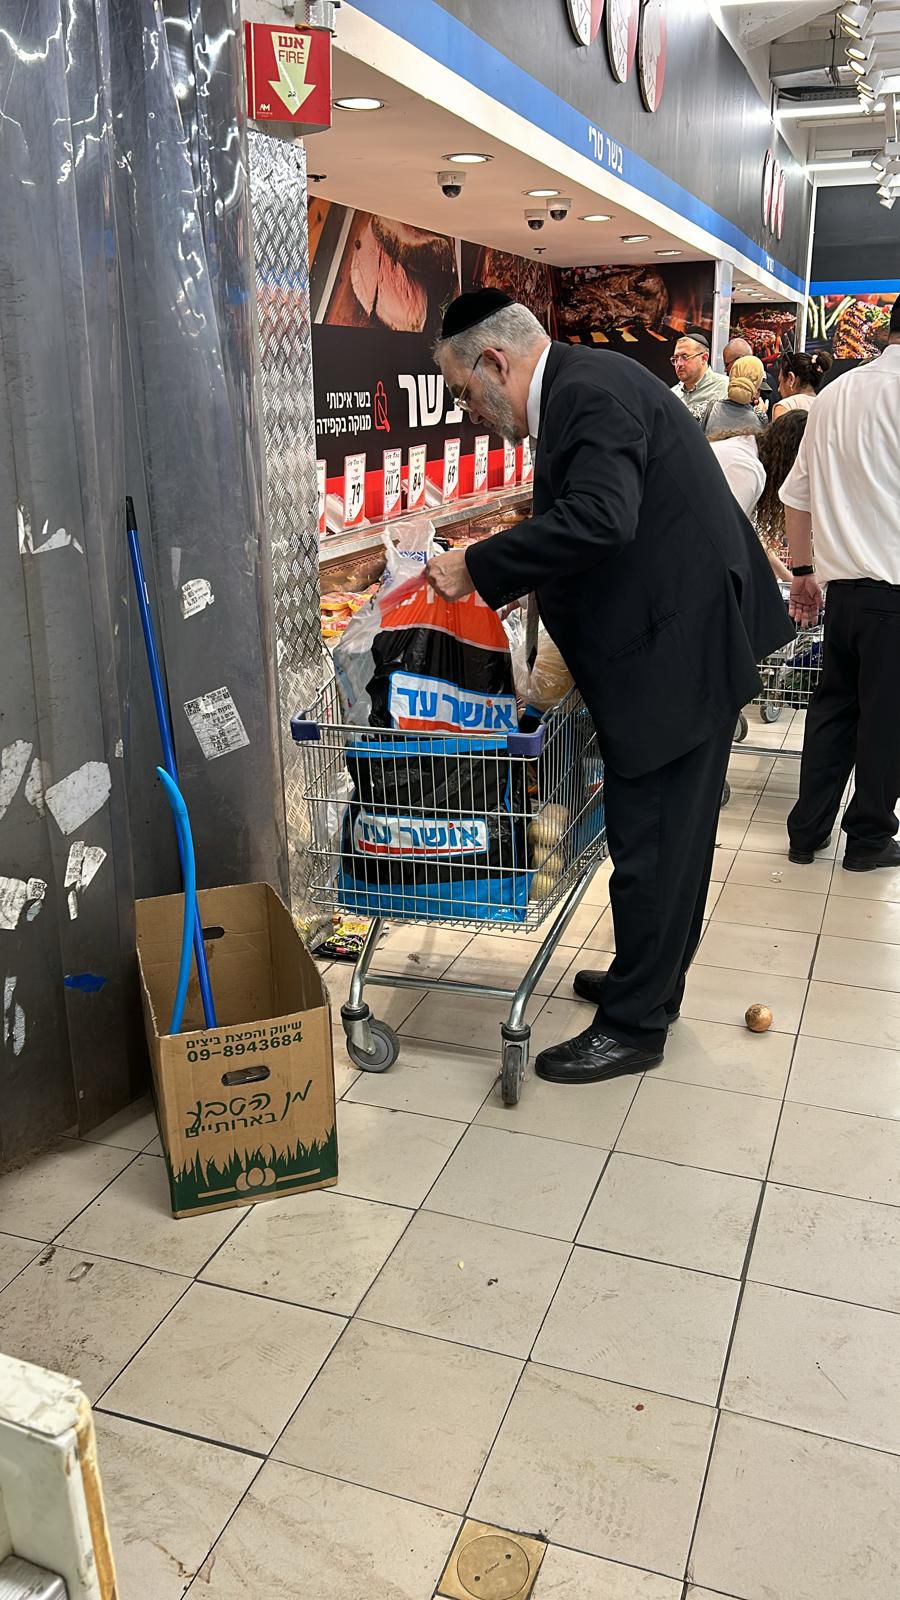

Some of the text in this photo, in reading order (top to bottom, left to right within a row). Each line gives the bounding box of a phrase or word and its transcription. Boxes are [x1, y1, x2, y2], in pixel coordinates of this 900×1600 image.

[278, 36, 304, 49] אש
[278, 50, 304, 64] FIRE
[588, 125, 623, 174] בשר טרי
[326, 391, 371, 409] בשר איכותי
[316, 414, 372, 437] מנוקה בקפידה
[396, 687, 516, 729] אושר עד
[399, 822, 482, 847] אושר
[186, 1020, 302, 1050] שיווק והפצת ביצים
[186, 1031, 304, 1063] 09-8943684
